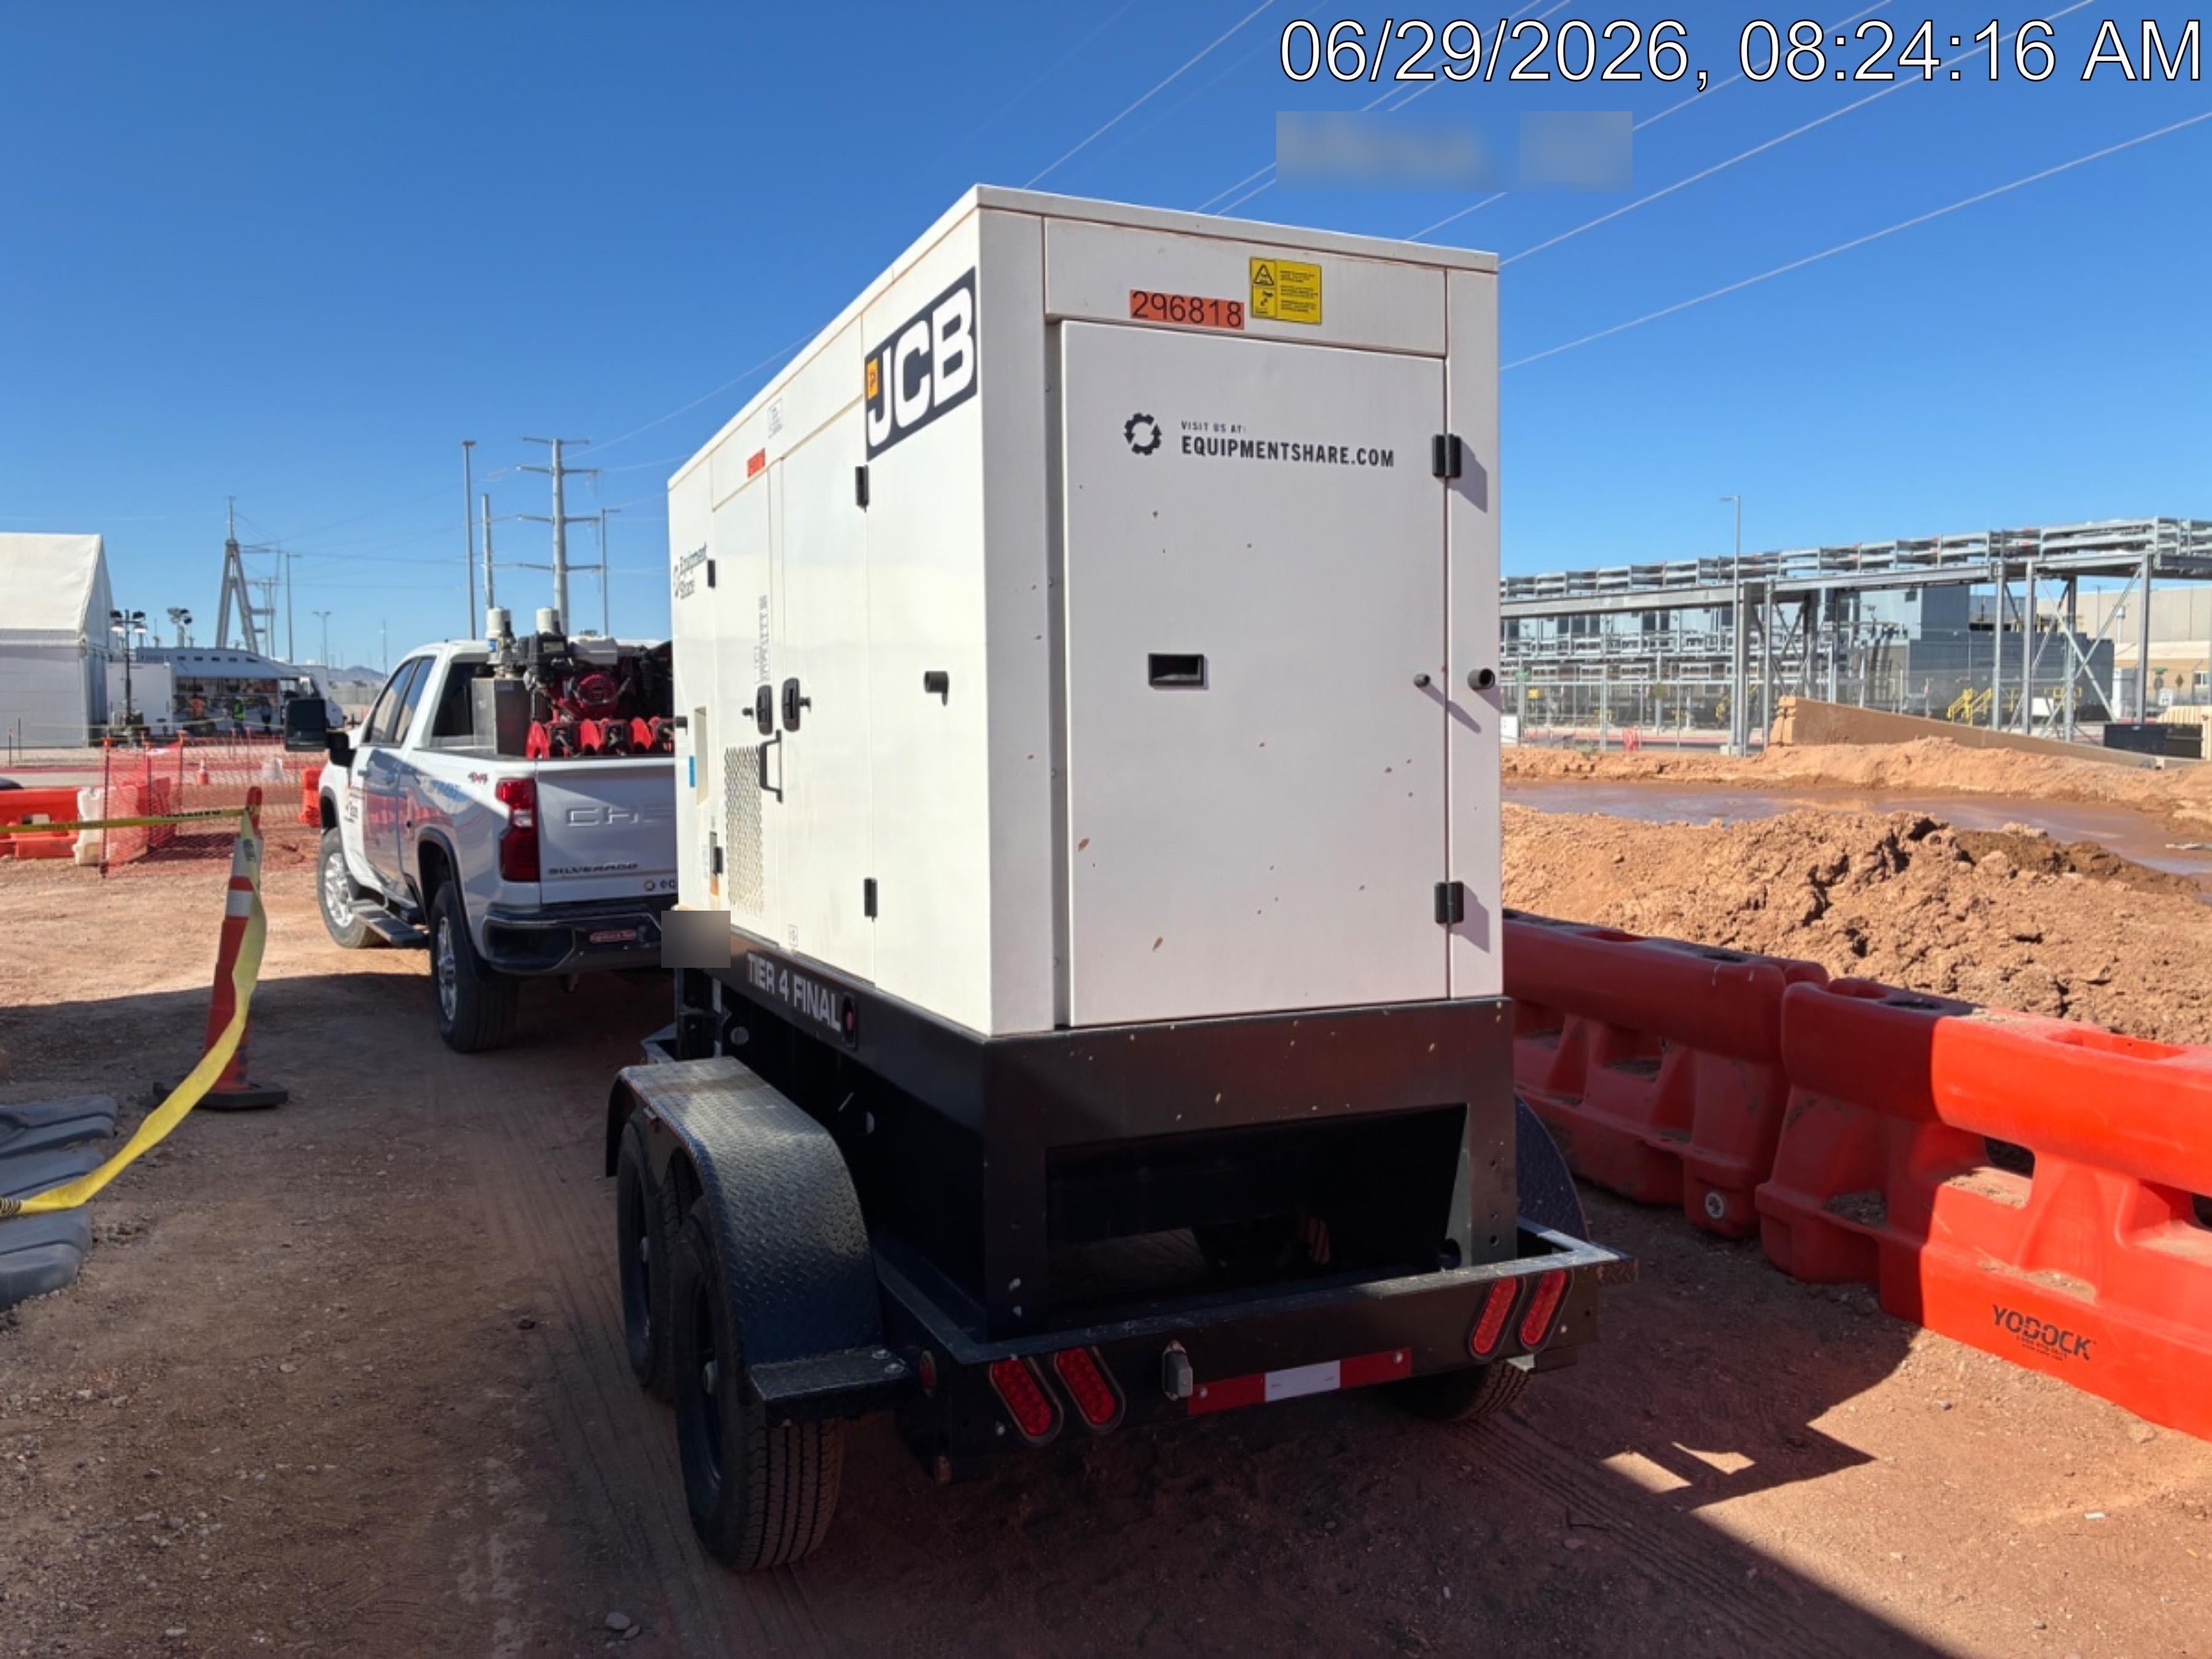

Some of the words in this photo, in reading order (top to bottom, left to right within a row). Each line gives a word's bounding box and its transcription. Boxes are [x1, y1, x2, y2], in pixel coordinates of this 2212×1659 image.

[1132, 291, 1242, 327] 296818
[866, 286, 975, 448] JCB
[1181, 420, 1209, 431] VISIT
[1214, 422, 1226, 433] US
[1181, 435, 1394, 467] EQUIPMENTSHARE.COM
[548, 863, 638, 875] SILVERADO
[747, 952, 775, 997] TIER
[779, 968, 790, 1003] 4
[793, 974, 842, 1033] FINAL
[1992, 1303, 2091, 1362] YODOCK
